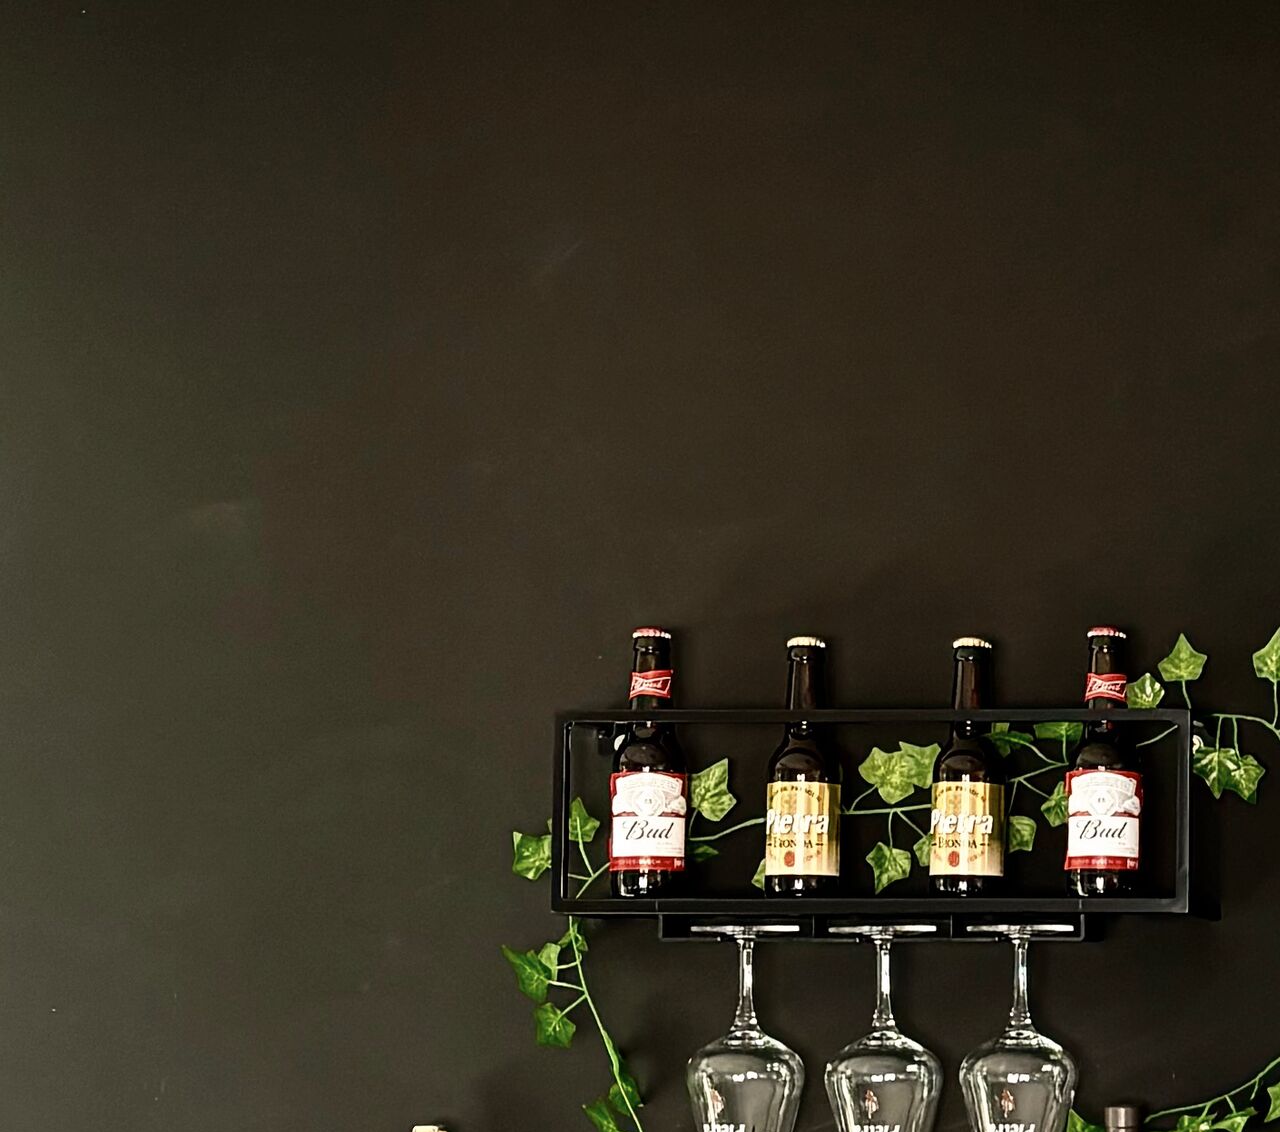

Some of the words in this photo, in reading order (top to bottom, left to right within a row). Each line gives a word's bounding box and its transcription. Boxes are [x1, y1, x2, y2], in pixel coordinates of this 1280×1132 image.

[623, 819, 675, 841] Bud
[766, 808, 829, 835] Pietra
[931, 808, 994, 835] Pietra
[1077, 818, 1129, 840] Bud
